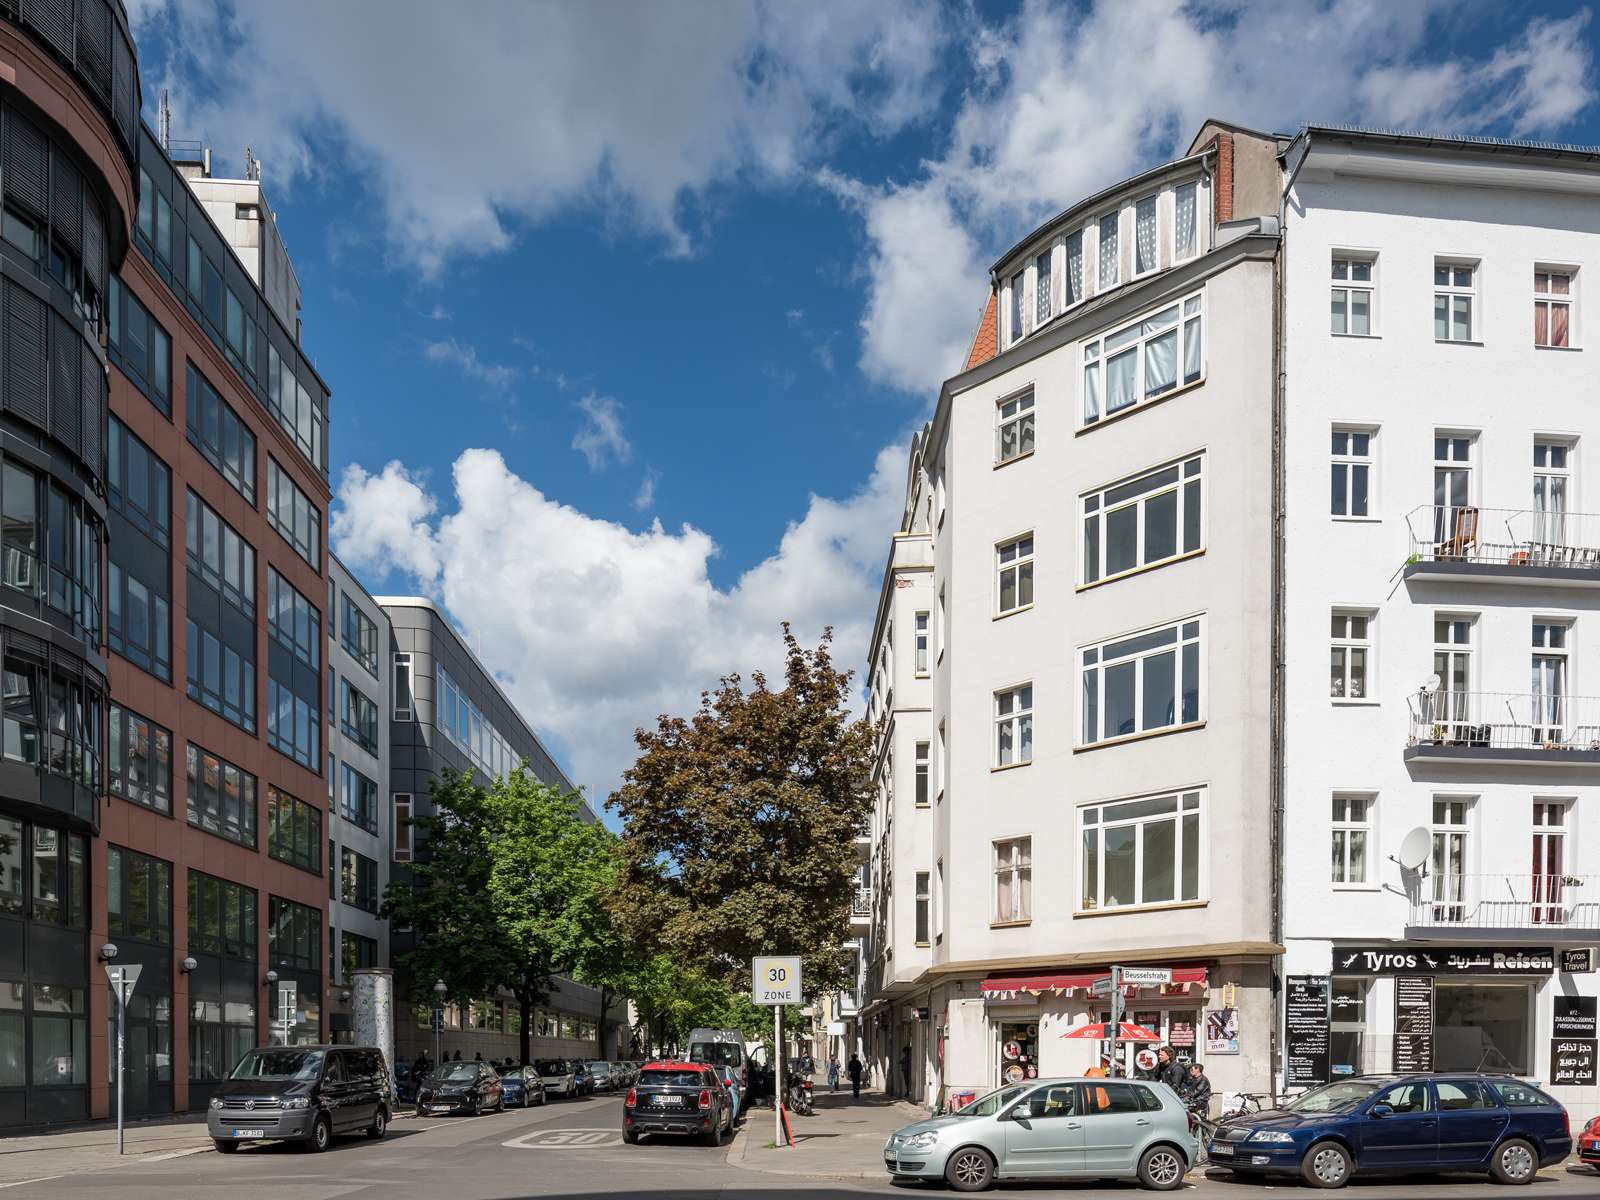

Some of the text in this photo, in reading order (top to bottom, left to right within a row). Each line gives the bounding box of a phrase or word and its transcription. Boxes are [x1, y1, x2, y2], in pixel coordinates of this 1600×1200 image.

[1363, 951, 1417, 972] Tyros
[1493, 952, 1553, 969] Reisen
[1565, 952, 1586, 961] Tyros
[1564, 962, 1587, 971] Travel
[768, 968, 786, 982] 30
[1125, 970, 1168, 980] Beusselstraße
[764, 991, 792, 1000] ZONE
